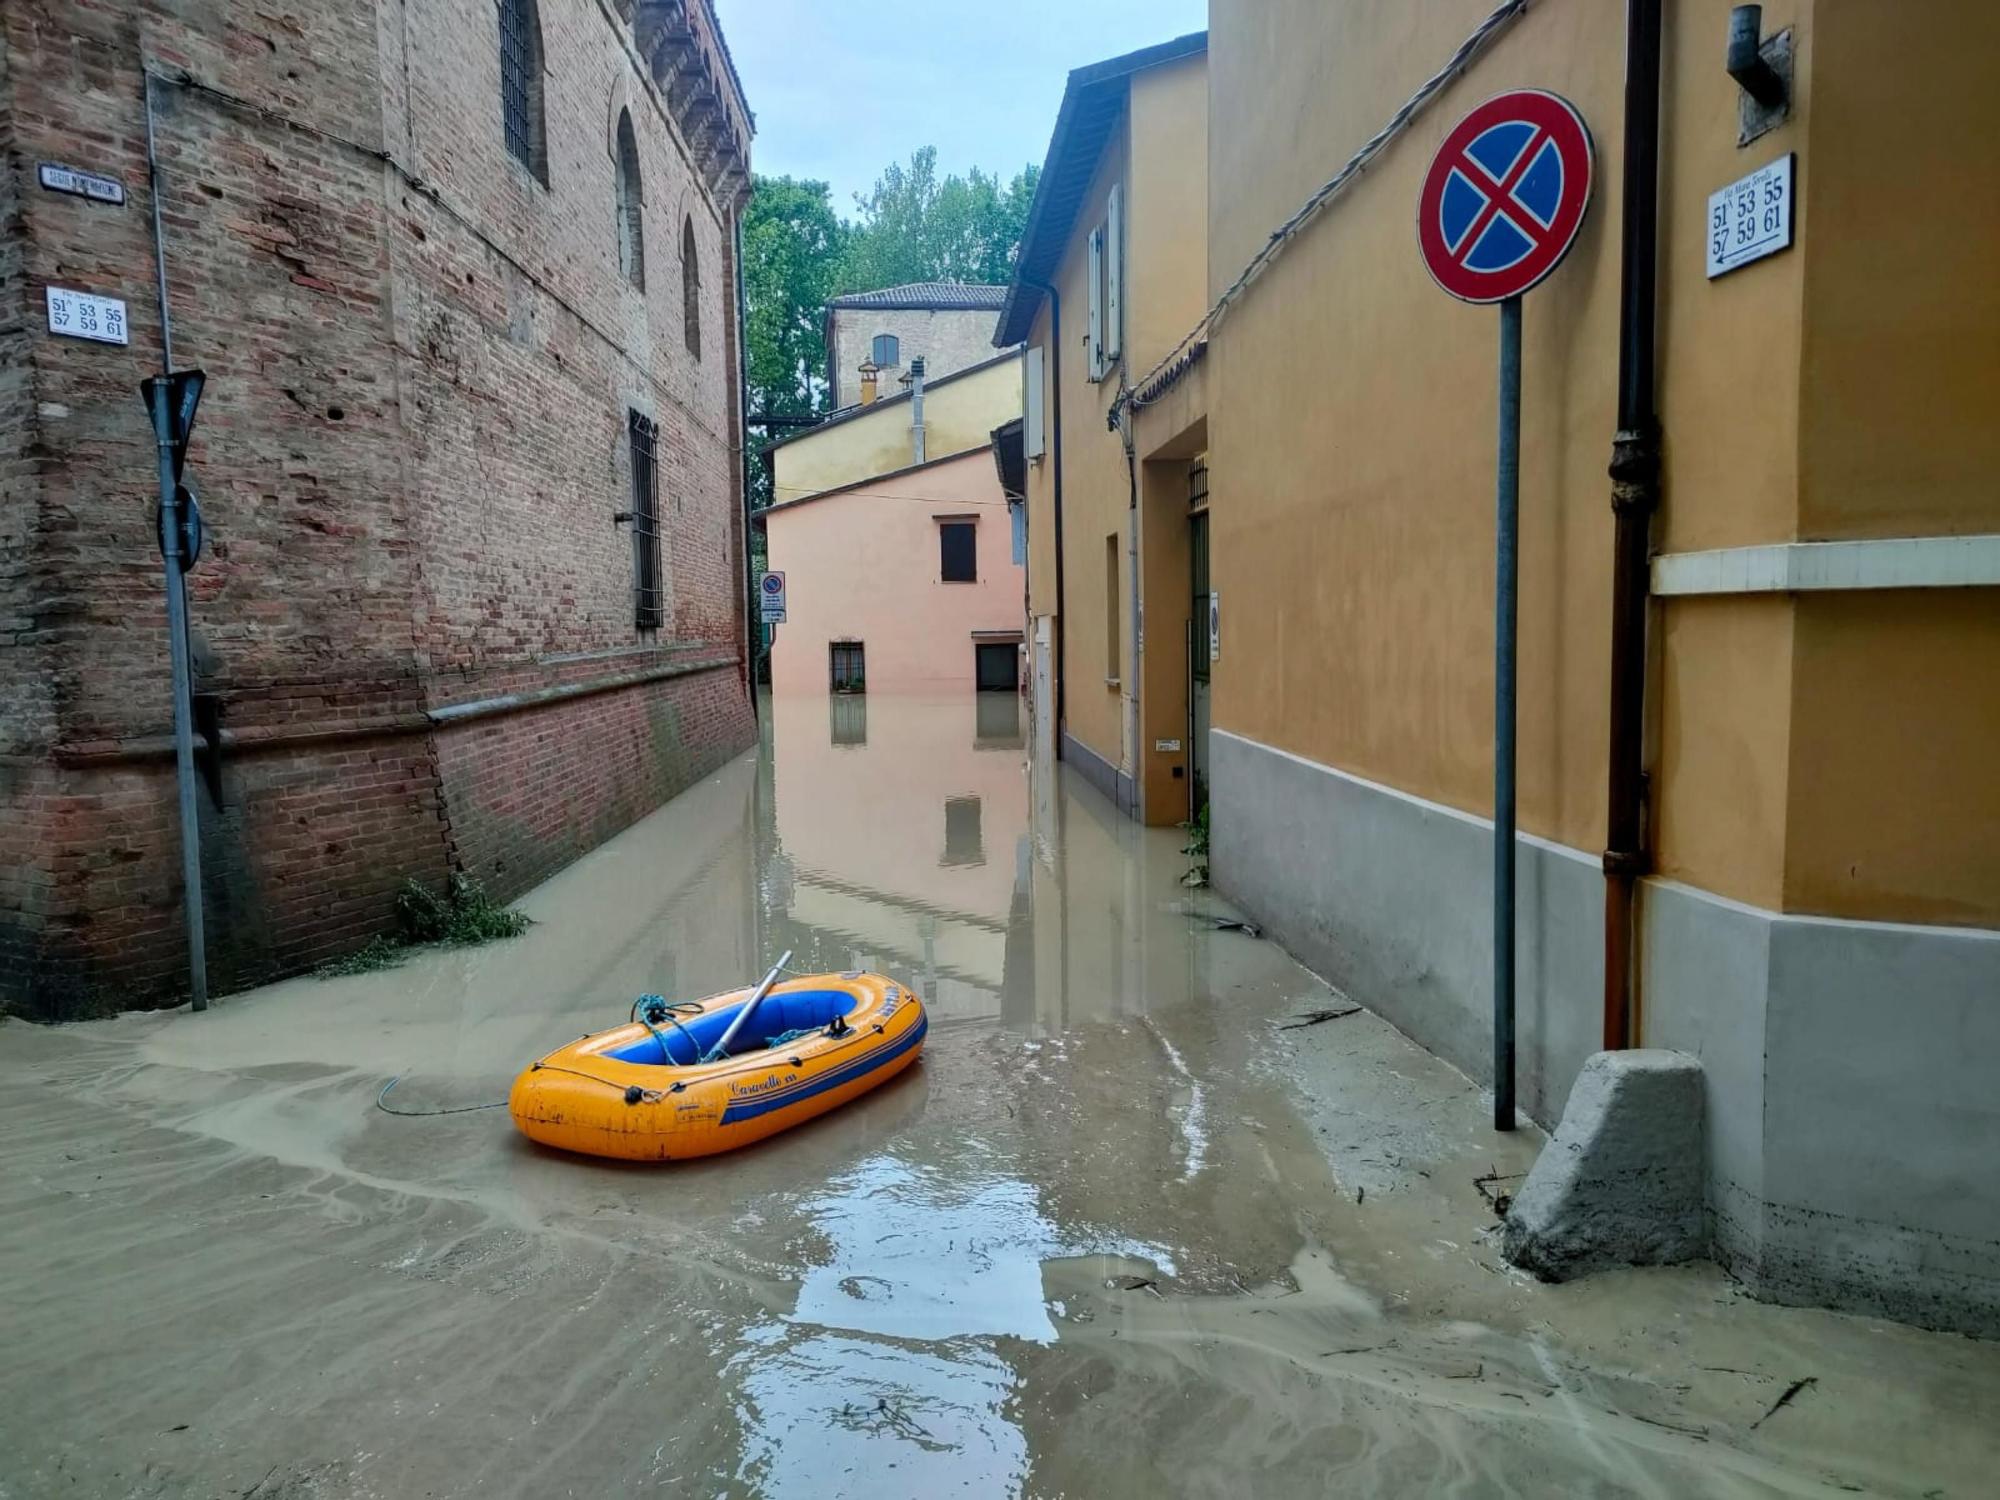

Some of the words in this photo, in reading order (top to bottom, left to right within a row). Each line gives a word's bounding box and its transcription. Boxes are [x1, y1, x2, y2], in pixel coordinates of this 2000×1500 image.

[1737, 190, 1755, 218] 53
[1764, 176, 1782, 205] 55
[1713, 228, 1729, 255] 57
[1737, 217, 1755, 244] 59
[1764, 205, 1780, 232] 61
[54, 312, 70, 326] 57
[80, 317, 97, 331] 59
[106, 322, 122, 336] 61
[79, 303, 96, 317] 53
[105, 308, 122, 322] 55
